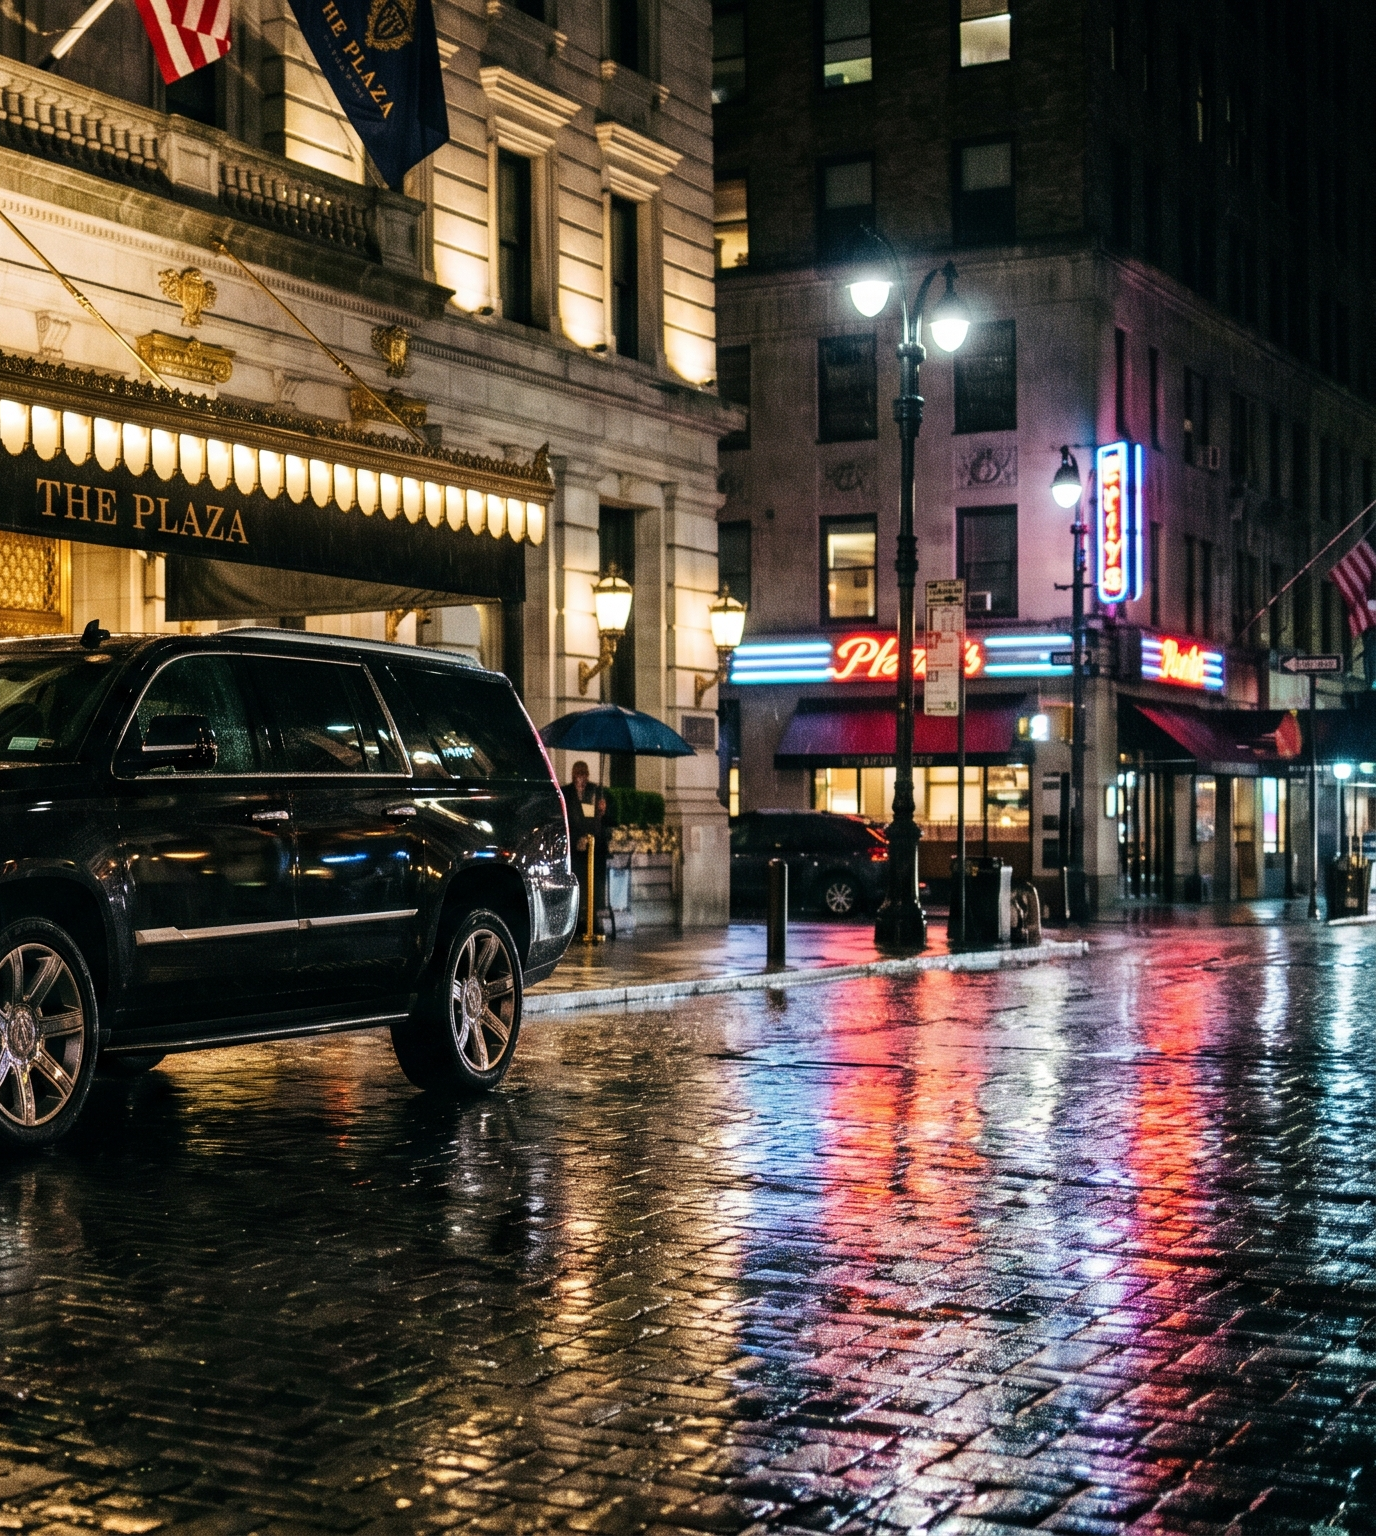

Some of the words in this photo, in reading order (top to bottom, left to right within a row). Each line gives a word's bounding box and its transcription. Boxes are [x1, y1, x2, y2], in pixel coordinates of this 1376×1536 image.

[322, 0, 348, 38] HE
[342, 40, 394, 119] PLAZA
[36, 478, 117, 525] THE
[132, 493, 249, 544] PLAZA
